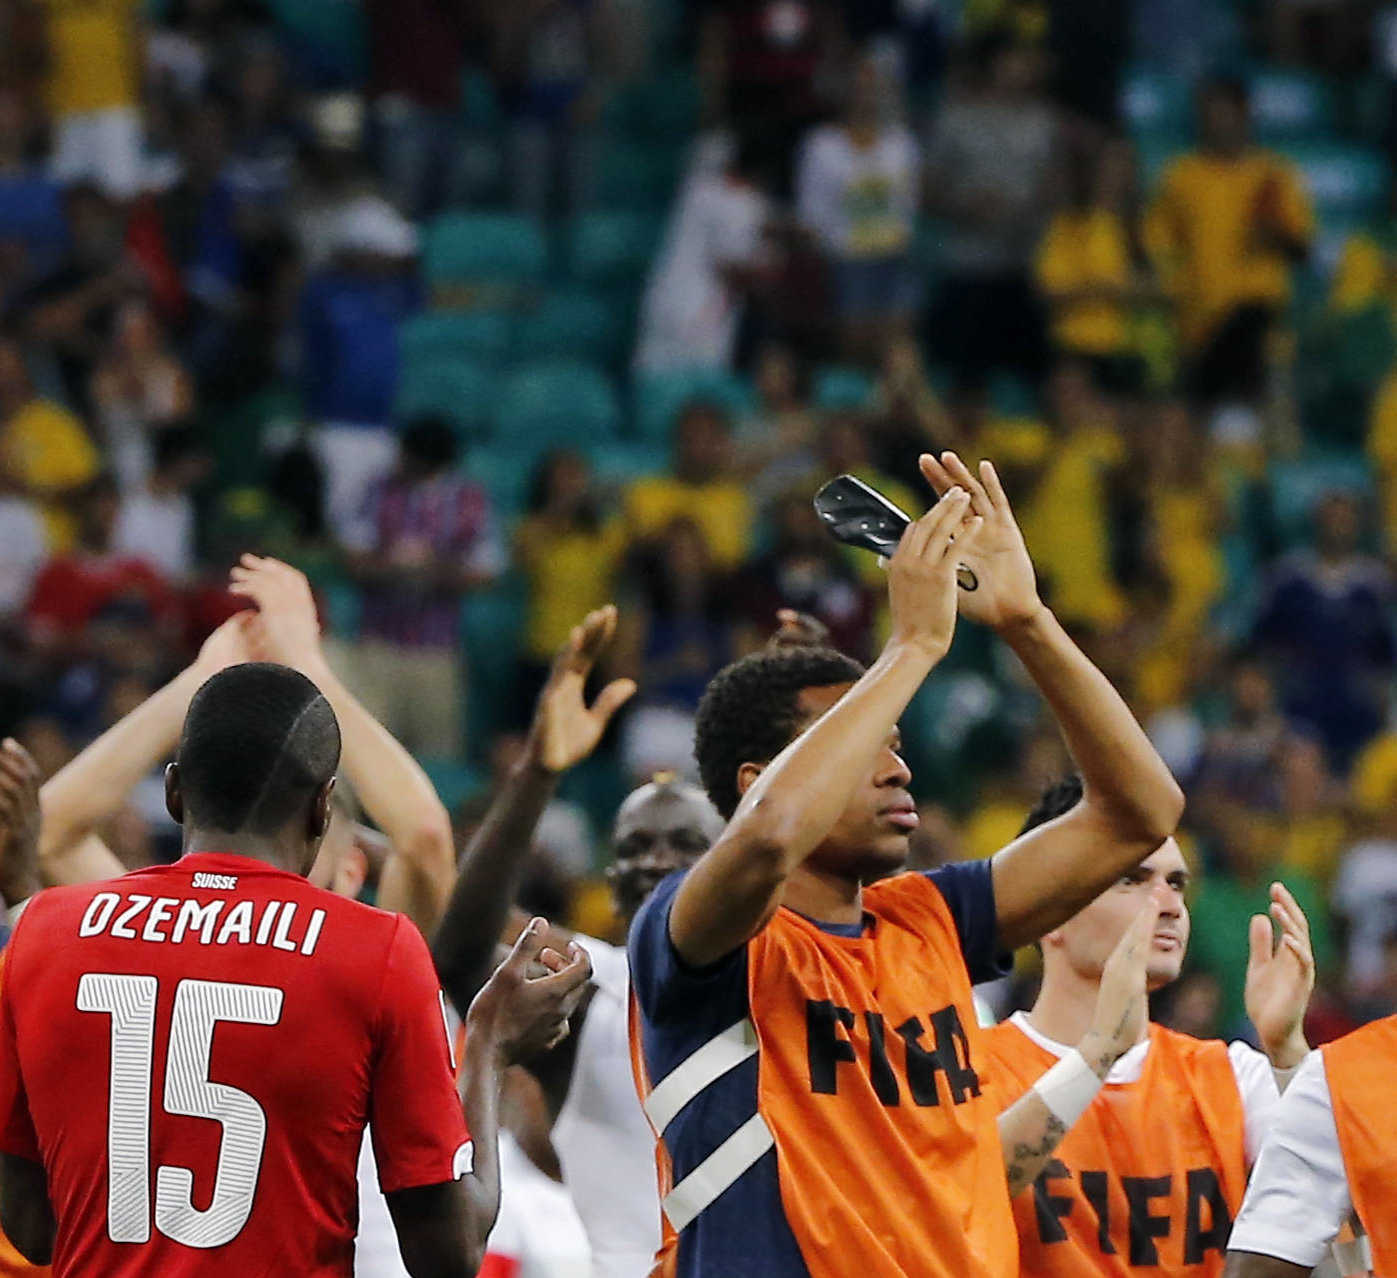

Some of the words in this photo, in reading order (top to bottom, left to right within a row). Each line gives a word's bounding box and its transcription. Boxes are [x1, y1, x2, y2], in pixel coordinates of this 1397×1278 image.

[78, 892, 326, 956] DZEMAILI
[192, 872, 238, 890] SUISSE
[77, 973, 284, 1249] 15
[1034, 1157, 1235, 1267] FIFA
